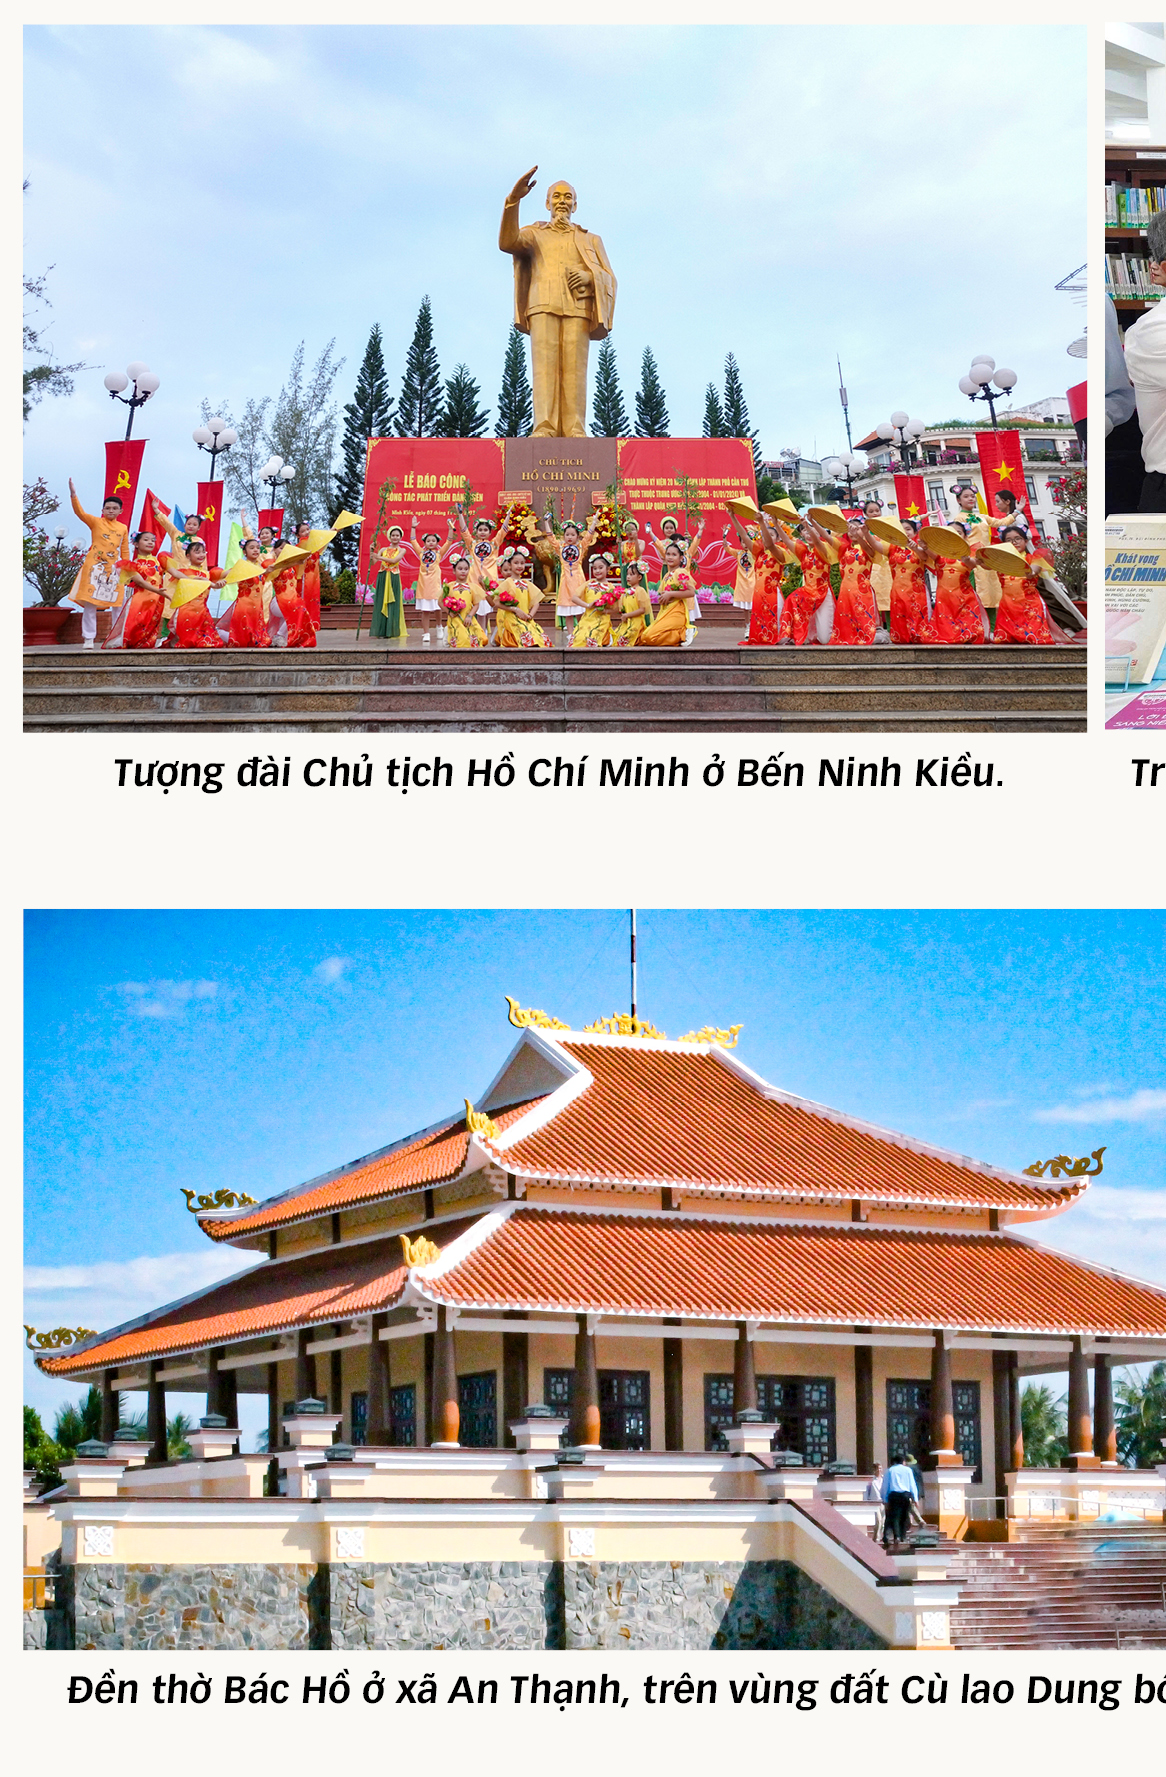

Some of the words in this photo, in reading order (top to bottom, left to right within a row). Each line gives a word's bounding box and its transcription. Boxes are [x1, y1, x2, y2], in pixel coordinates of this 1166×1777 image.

[404, 471, 414, 488] LỄ
[417, 473, 436, 488] BÁO
[522, 469, 538, 481] HỒ
[542, 472, 564, 481] CHÍ
[567, 472, 600, 481] MINH
[1115, 553, 1137, 563] Khát
[1138, 555, 1159, 565] vọng
[1114, 564, 1136, 581] CHÍ
